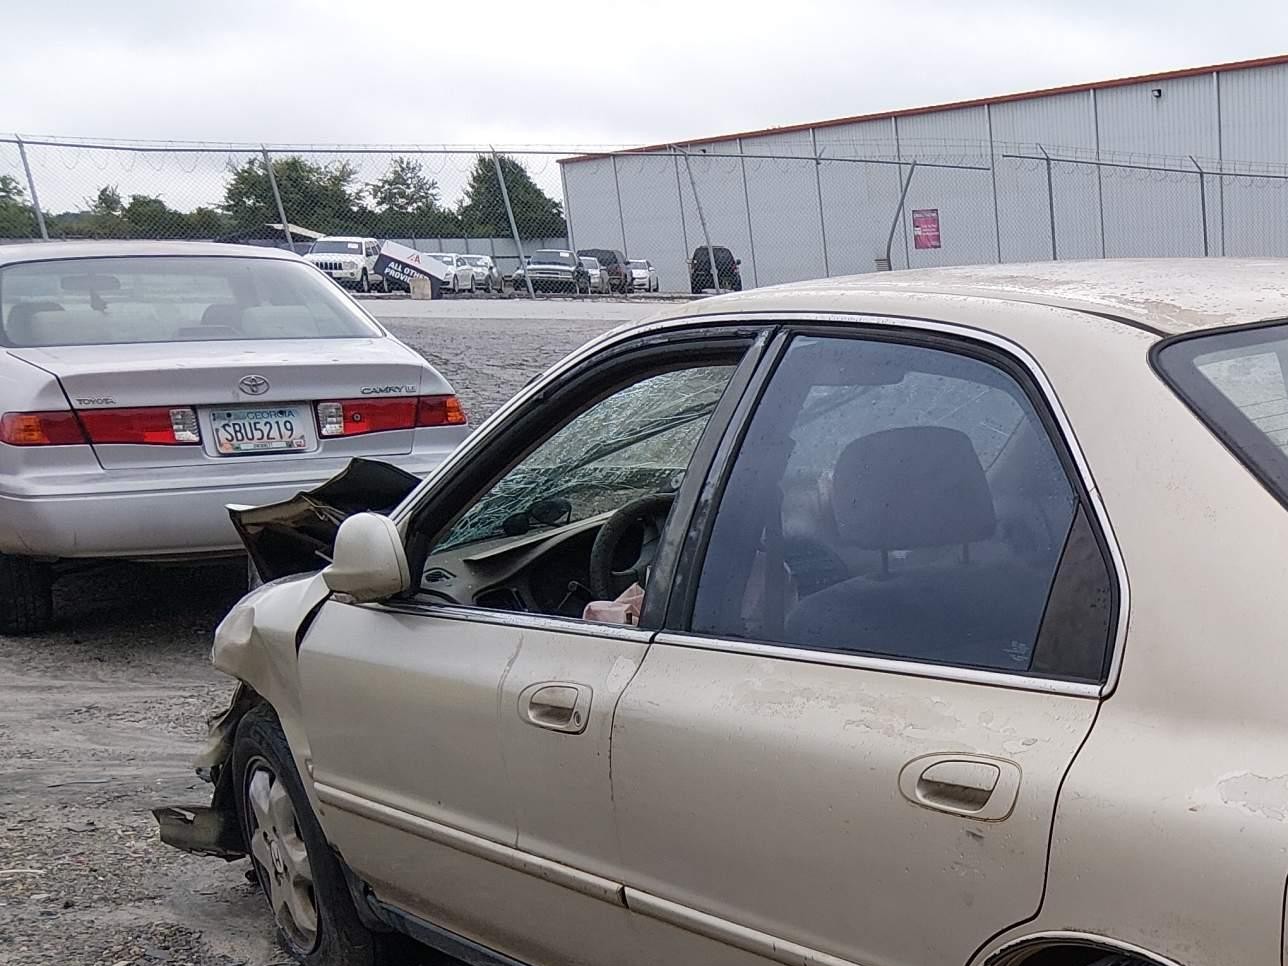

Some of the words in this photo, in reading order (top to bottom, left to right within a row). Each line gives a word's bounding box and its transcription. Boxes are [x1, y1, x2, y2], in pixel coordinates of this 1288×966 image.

[388, 261, 403, 272] ALL
[360, 385, 404, 395] CAMRY
[75, 397, 117, 405] TOYOTA
[246, 409, 295, 420] GEORGIA
[221, 419, 295, 442] SBU5219
